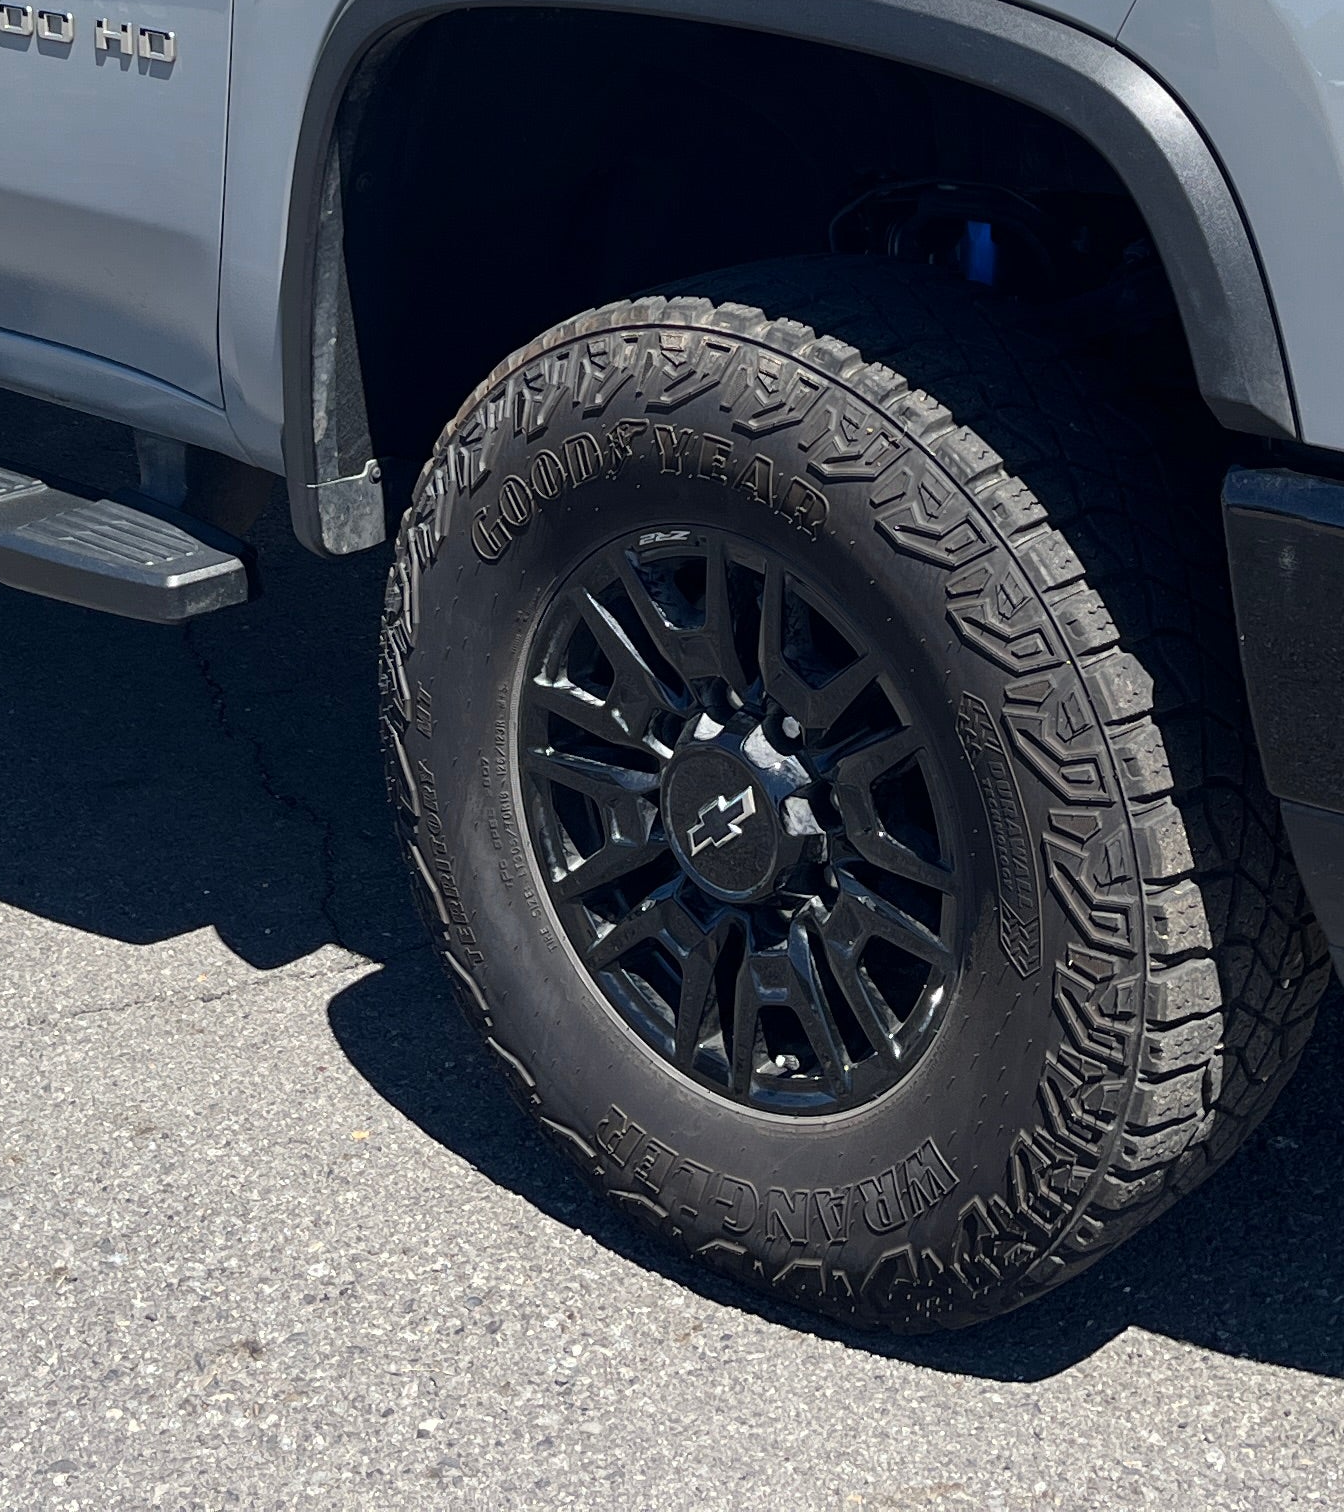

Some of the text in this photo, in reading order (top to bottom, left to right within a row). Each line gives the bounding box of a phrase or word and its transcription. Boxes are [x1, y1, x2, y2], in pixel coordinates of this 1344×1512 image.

[95, 17, 176, 62] HD
[639, 530, 691, 546] ZR2
[417, 757, 486, 968] TERRITORY
[981, 777, 1013, 894] TECHNOLOGY
[988, 760, 1034, 910] DURAWALL
[594, 1104, 961, 1245] WRANGLER
